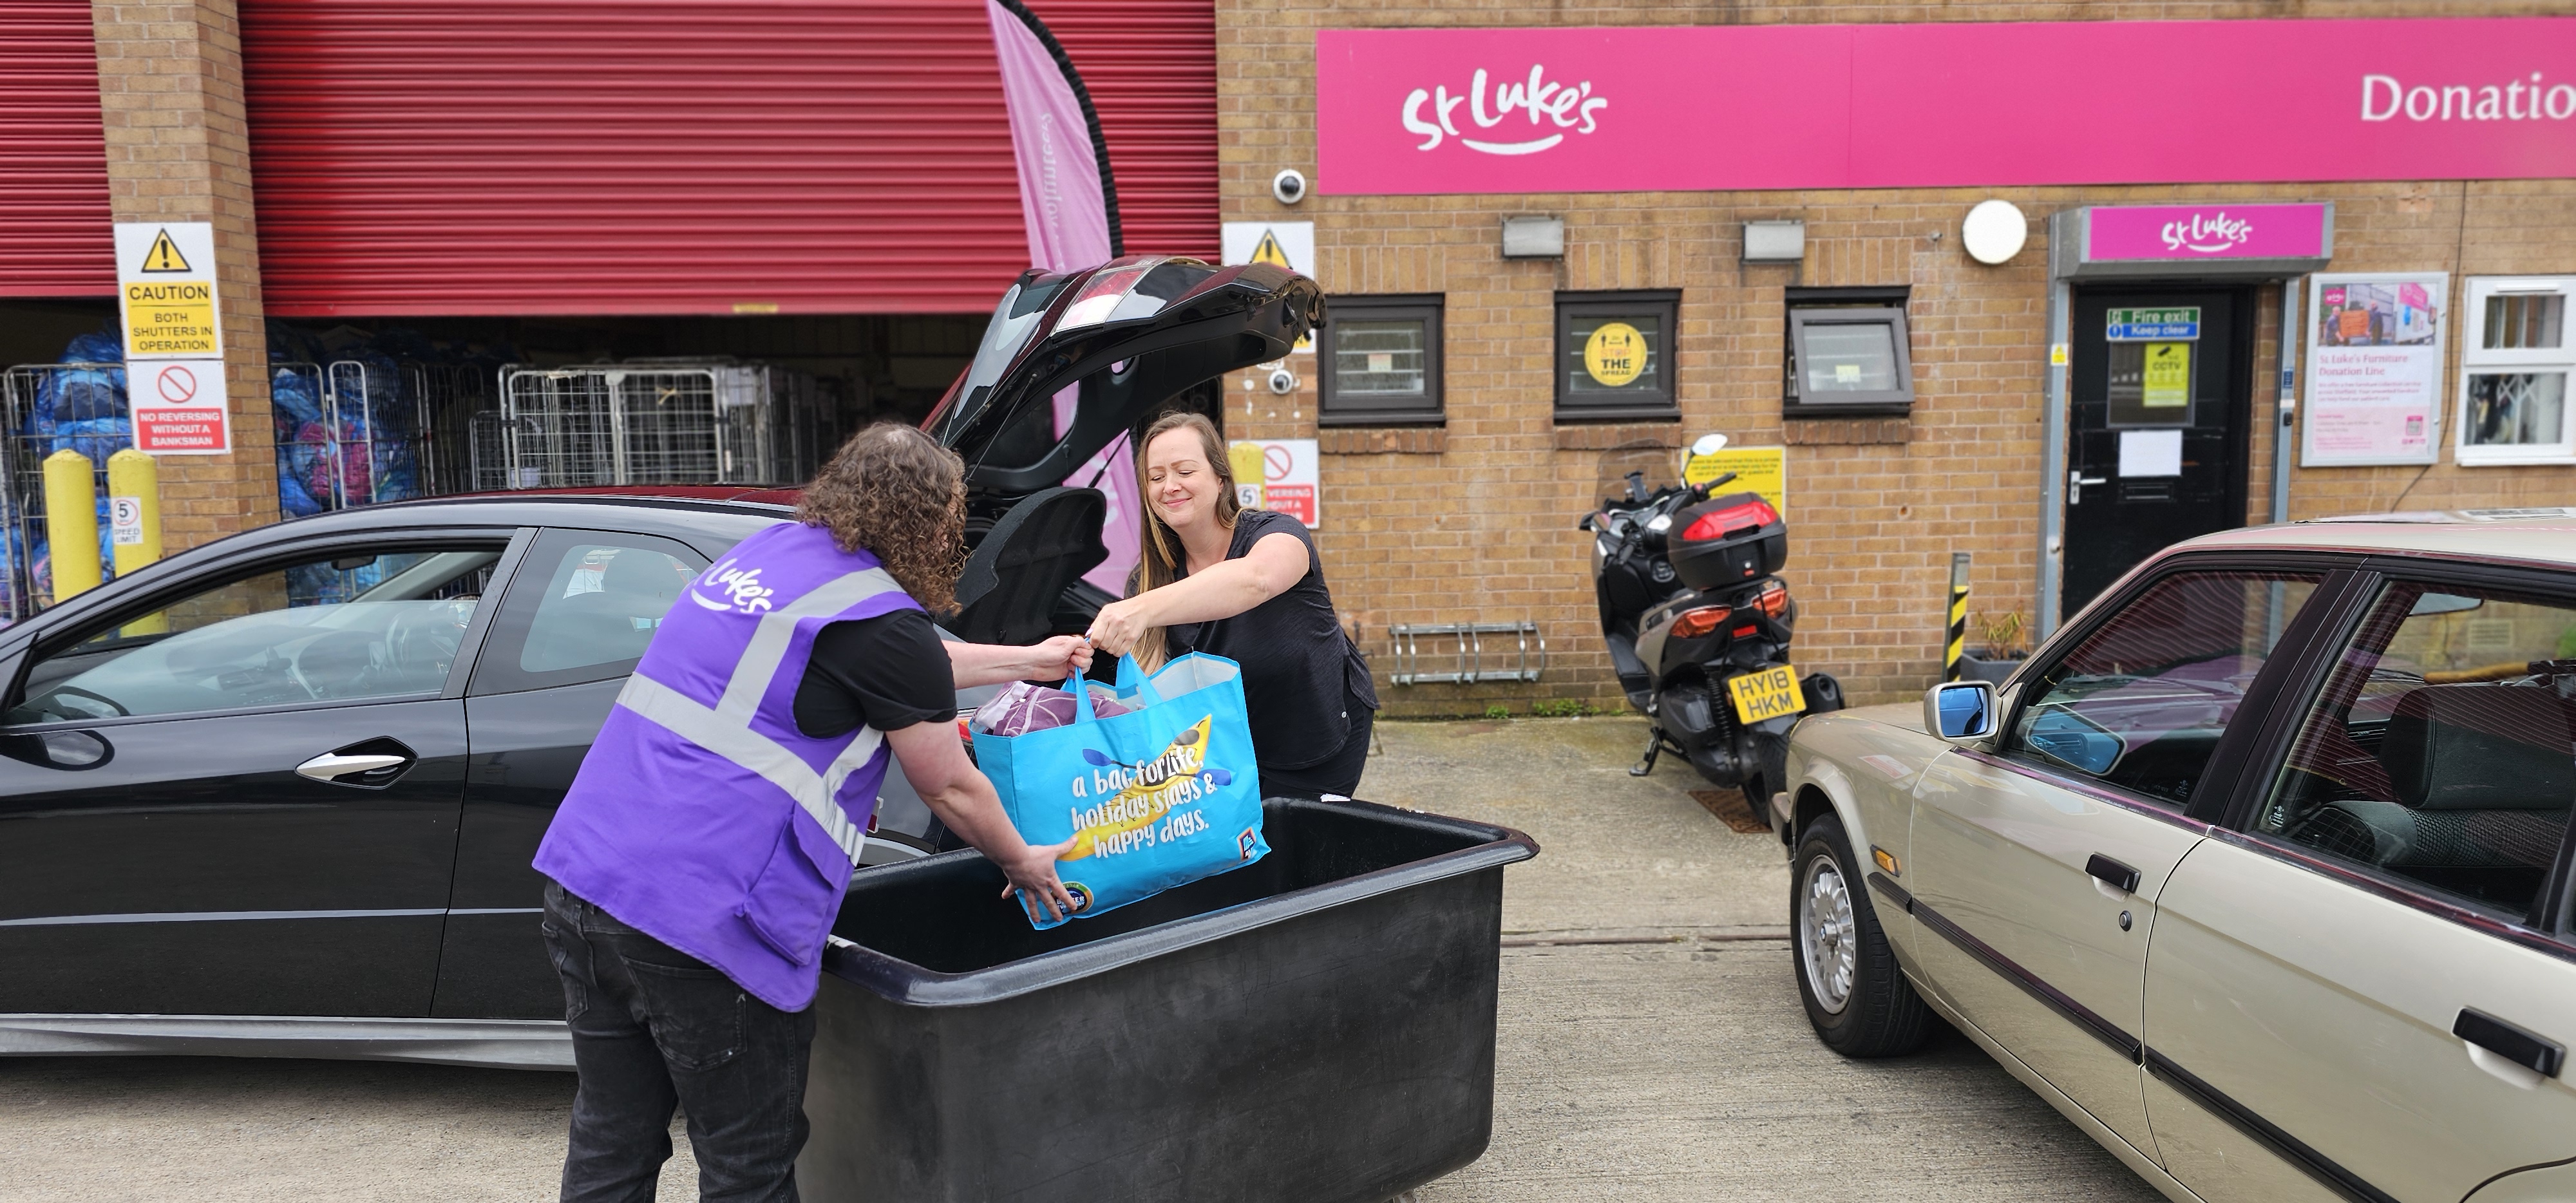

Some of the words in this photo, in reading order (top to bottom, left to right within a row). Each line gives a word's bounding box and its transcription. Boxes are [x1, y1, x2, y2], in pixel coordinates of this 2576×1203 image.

[2361, 71, 2576, 121] Donatio
[1402, 85, 1465, 151] St
[1471, 64, 1608, 134] Luke's
[2161, 221, 2190, 251] St
[2192, 211, 2253, 243] Luke's
[129, 285, 209, 300] CAUTION
[155, 312, 188, 323] BOTH
[2132, 310, 2161, 323] Fire
[2164, 309, 2190, 322] exit
[133, 327, 197, 337] SHUTTERS
[201, 327, 212, 336] IN
[2131, 325, 2160, 336] Keep
[2163, 325, 2189, 334] clear
[139, 340, 209, 351] OPERATION
[1601, 348, 1631, 357] STOP
[2331, 354, 2361, 363] Luke's
[2363, 354, 2409, 363] Furniture
[1601, 359, 1631, 369] THE
[2152, 361, 2181, 370] CCTV
[2319, 366, 2362, 376] Donation
[2365, 366, 2385, 375] Line
[140, 413, 156, 422] NO
[158, 412, 220, 422] REVERSING
[151, 424, 201, 433] WITHOUT
[202, 424, 211, 433] A
[151, 437, 213, 446] BANKSMAN
[1242, 488, 1253, 504] 5
[1294, 499, 1302, 508] A
[118, 503, 129, 518] 5
[704, 558, 774, 613] Luke's
[1738, 670, 1790, 698] HY18
[1747, 691, 1794, 718] HKM
[1072, 775, 1088, 797] a
[1135, 759, 1164, 786] for
[1071, 793, 1150, 831] holiday
[1153, 777, 1202, 813] stays
[1204, 773, 1218, 795] &
[1093, 824, 1156, 858] happy
[1160, 810, 1209, 843] days.
